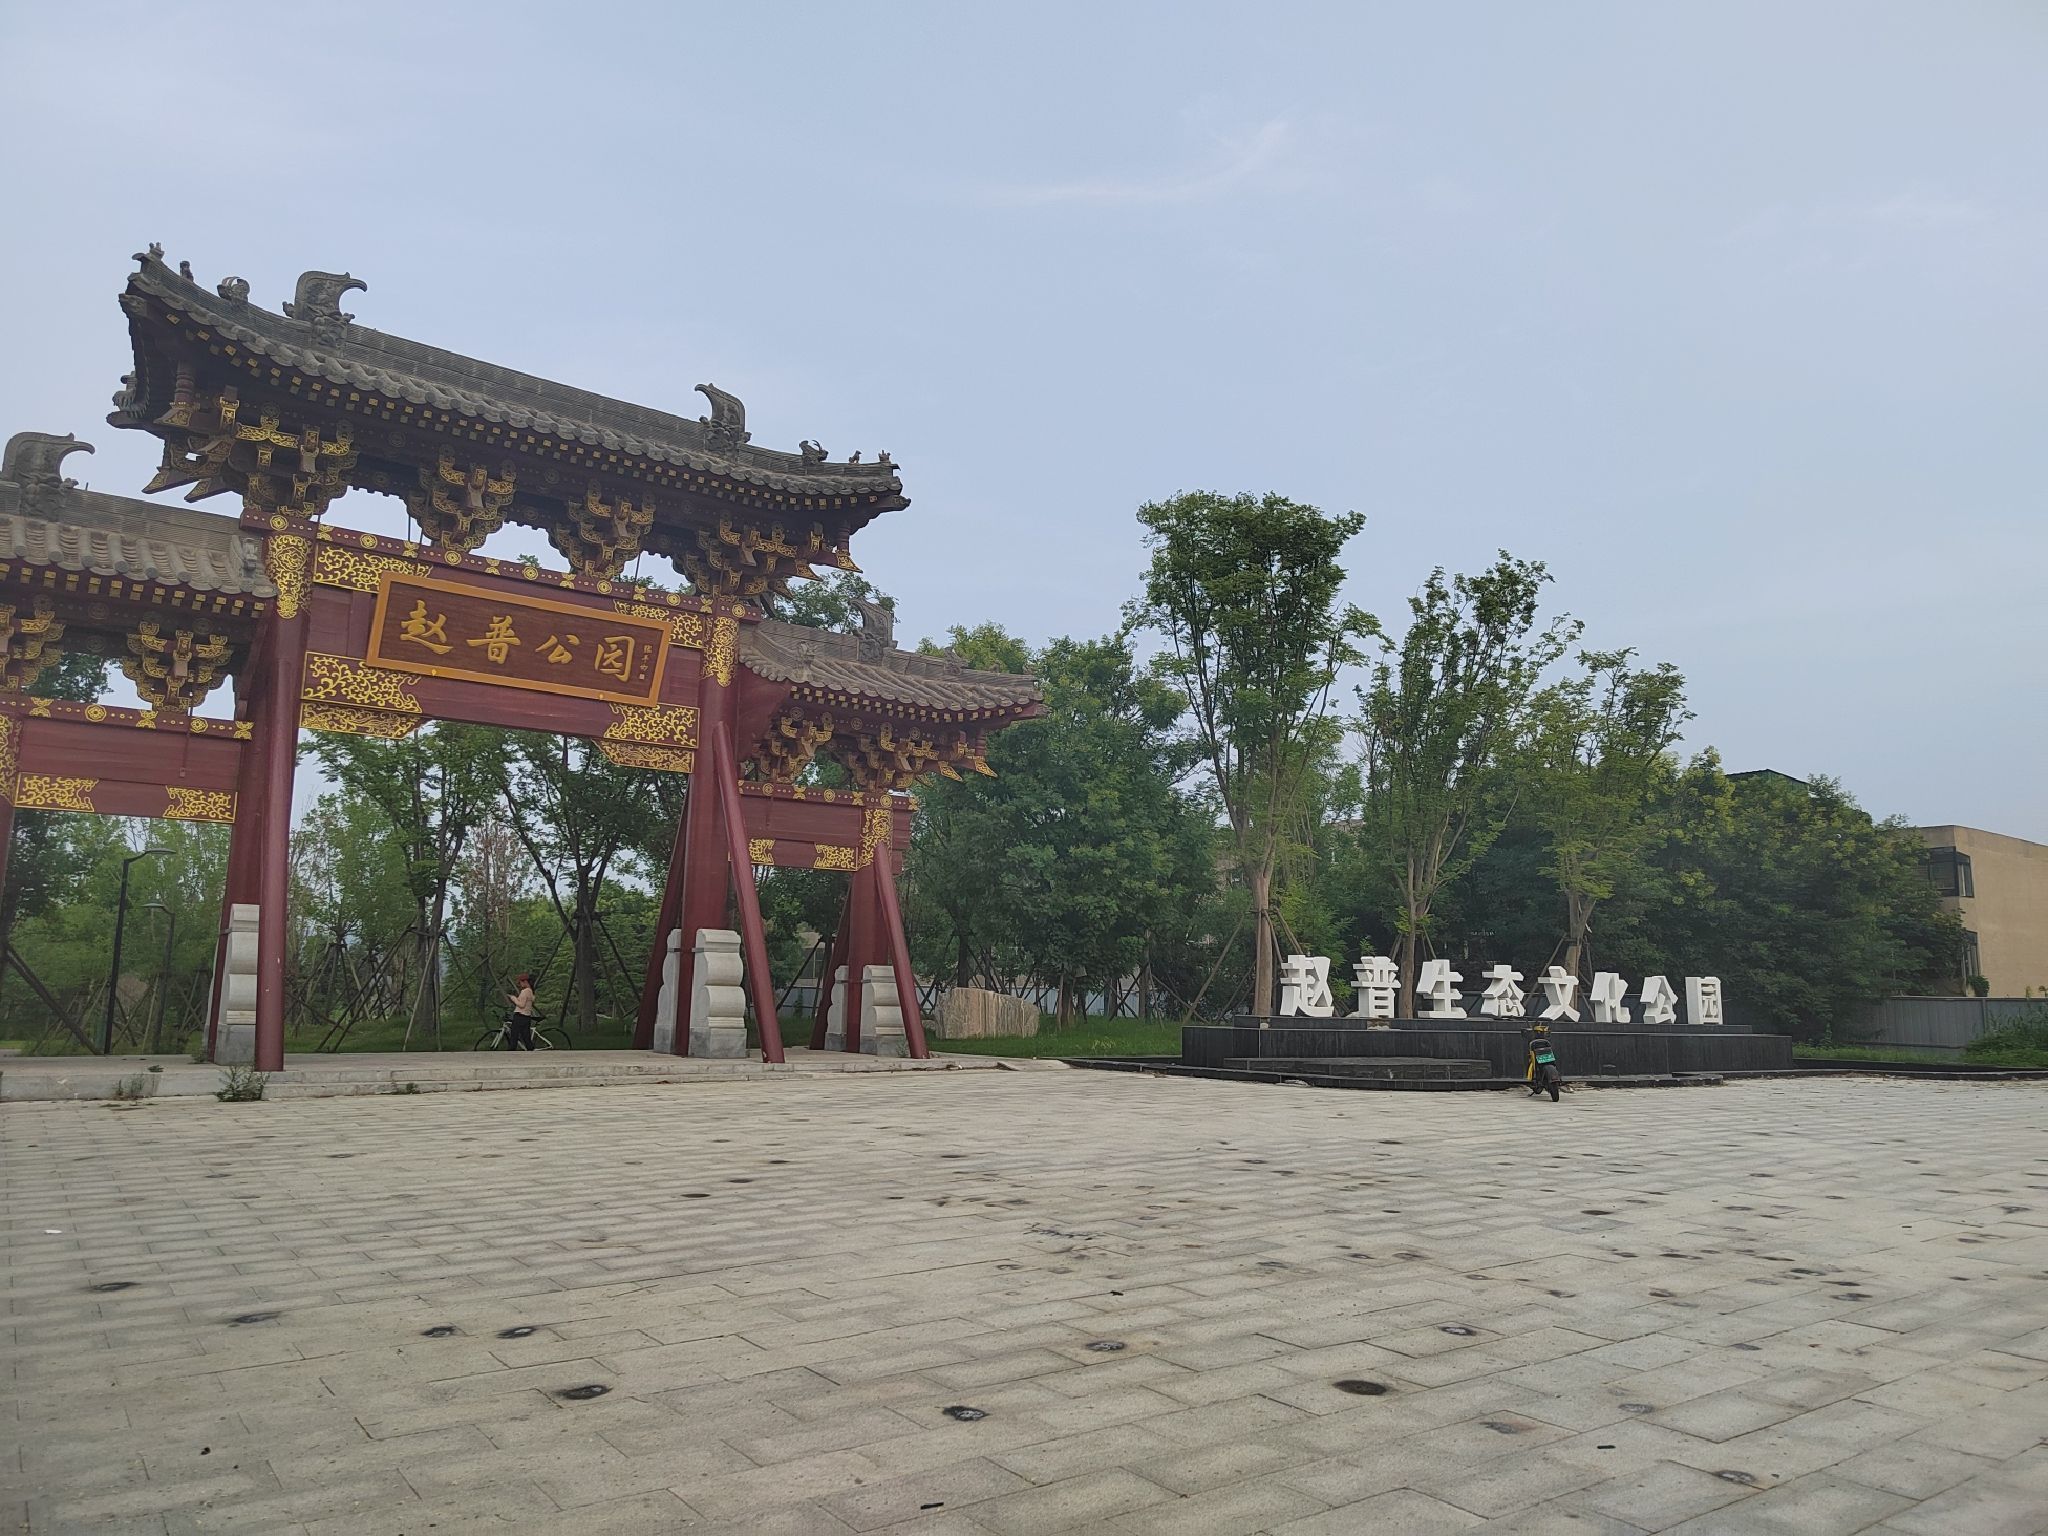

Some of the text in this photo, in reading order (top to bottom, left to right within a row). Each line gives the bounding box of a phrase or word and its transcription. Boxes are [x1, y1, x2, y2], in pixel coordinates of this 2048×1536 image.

[400, 599, 636, 682] 赵普公园
[1280, 954, 1723, 1025] 赵普生态文化公园
